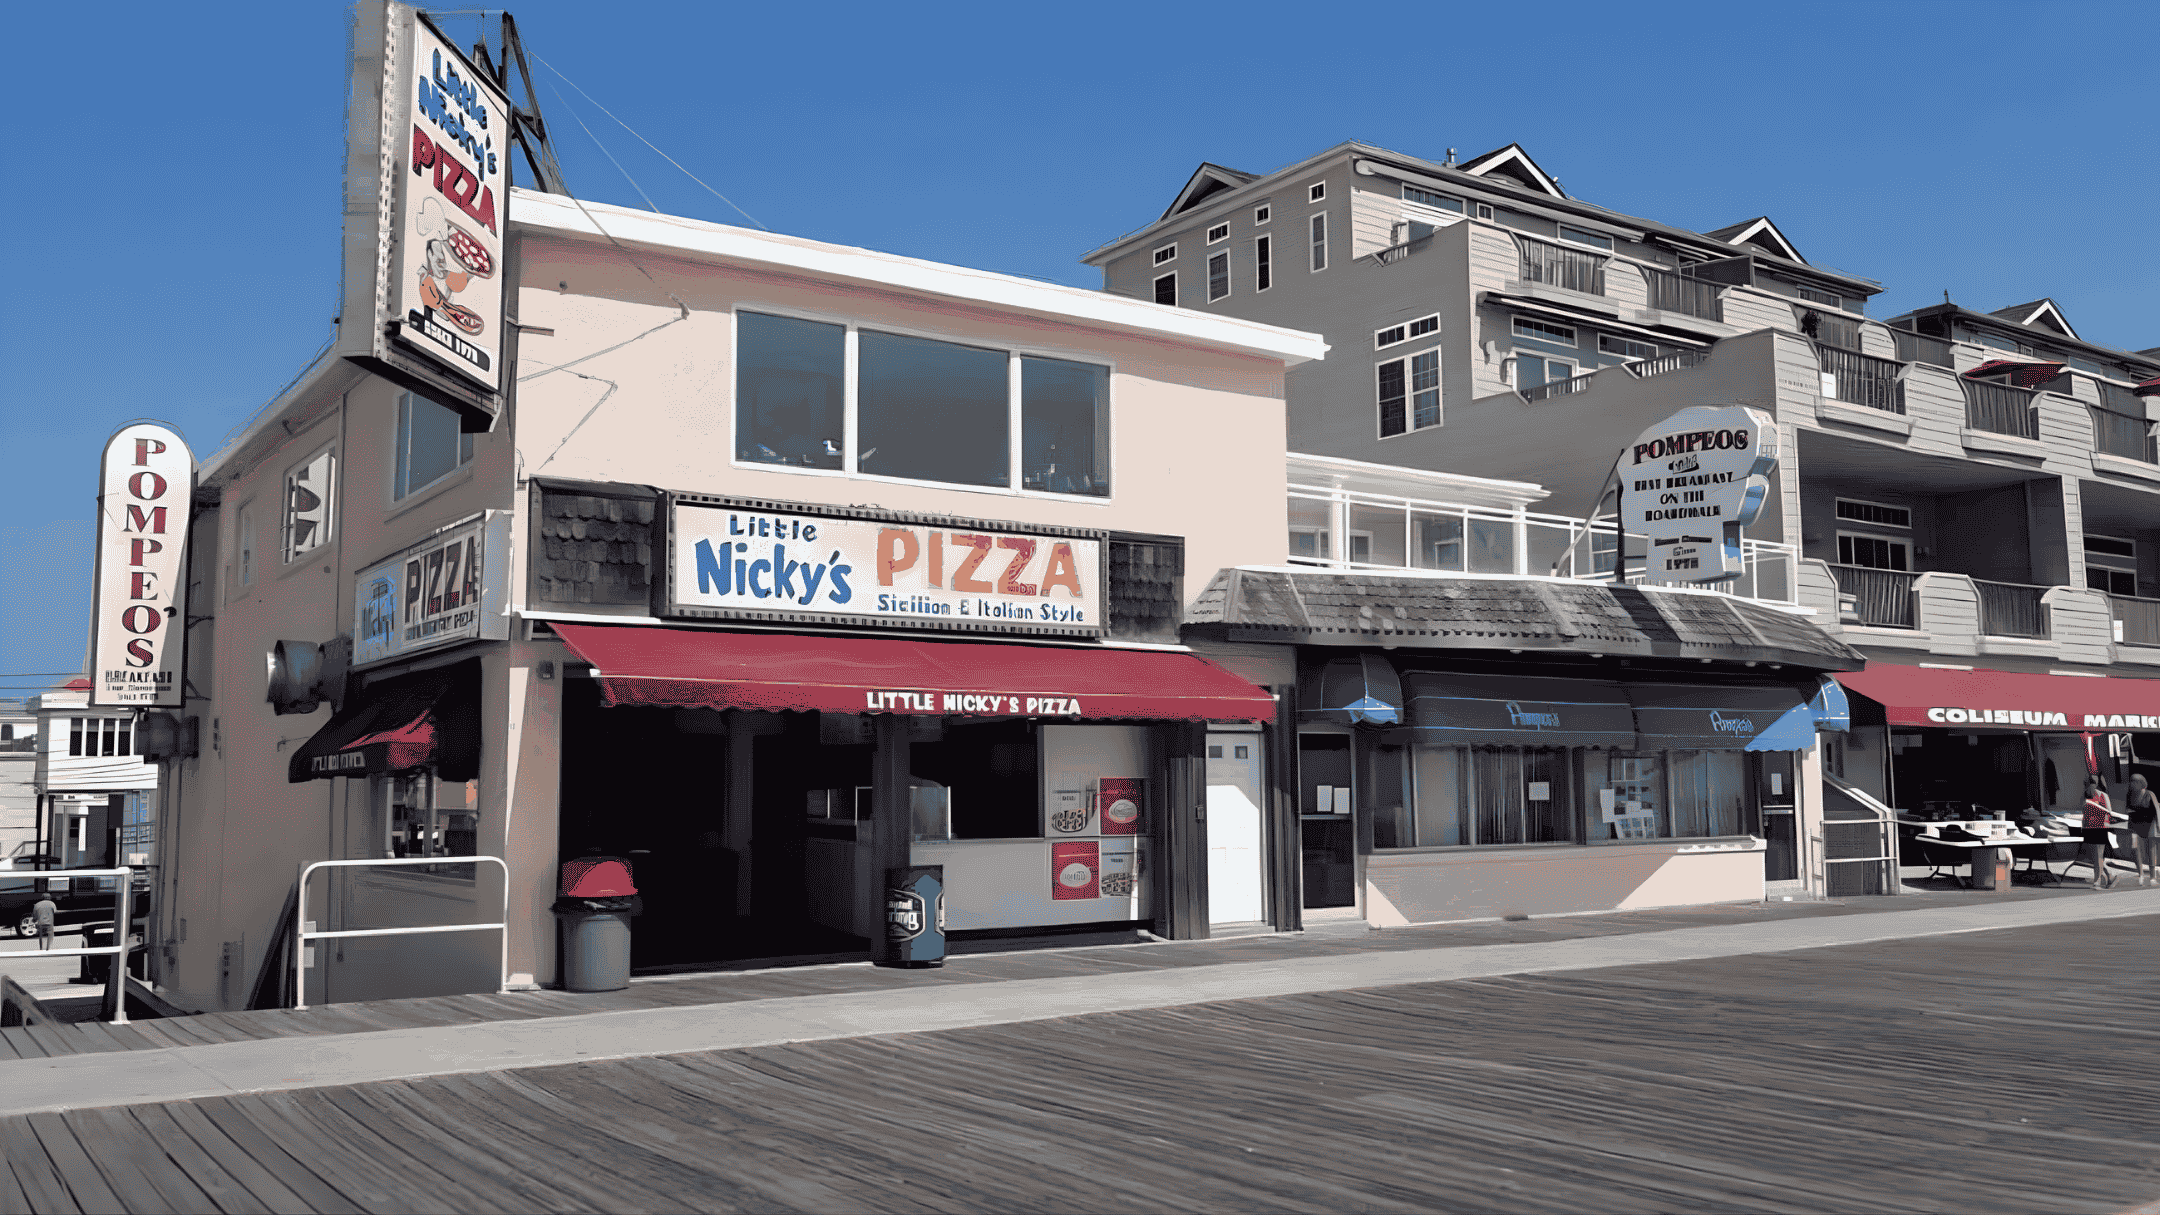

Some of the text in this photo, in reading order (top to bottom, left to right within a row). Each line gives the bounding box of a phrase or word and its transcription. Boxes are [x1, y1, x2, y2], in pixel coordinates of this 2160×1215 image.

[412, 123, 498, 239] PIZZA
[729, 514, 818, 543] Little
[403, 535, 479, 624] PIZZA
[695, 527, 1084, 605] Nicky's PIZZA
[1039, 602, 1084, 622] Style
[865, 691, 1082, 716] LITTLE NICKY'S PIZZA
[1927, 707, 2069, 727] COLISEUM
